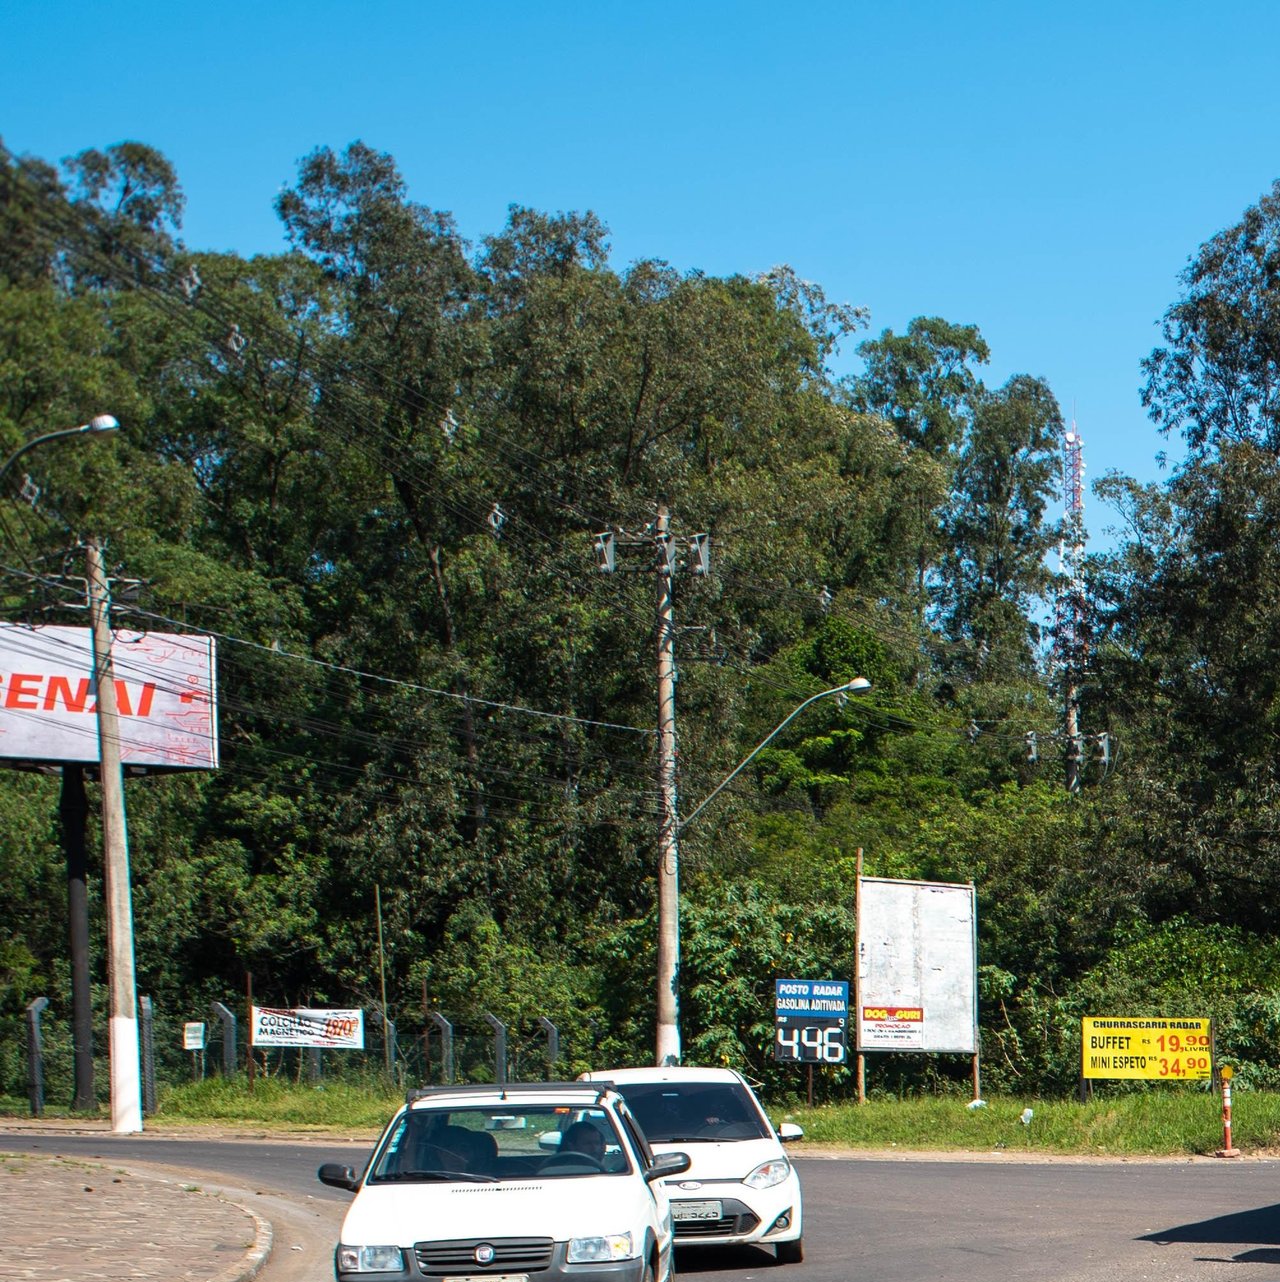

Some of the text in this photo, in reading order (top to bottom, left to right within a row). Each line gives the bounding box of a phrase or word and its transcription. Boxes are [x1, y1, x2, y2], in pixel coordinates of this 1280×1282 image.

[0, 672, 156, 717] ENAI
[779, 984, 843, 996] POSTO RADAR
[776, 998, 846, 1012] GASOLINA ADITIVADA
[865, 1008, 888, 1019] DOG
[896, 1010, 921, 1020] GURI
[838, 1018, 845, 1027] 9
[1093, 1020, 1202, 1029] CHURRASCARIA RADAR
[1090, 1036, 1132, 1049] BUFFET
[1156, 1035, 1210, 1053] 19,90
[1090, 1056, 1147, 1069] MINI ESPETO
[1159, 1057, 1208, 1077] 34,90
